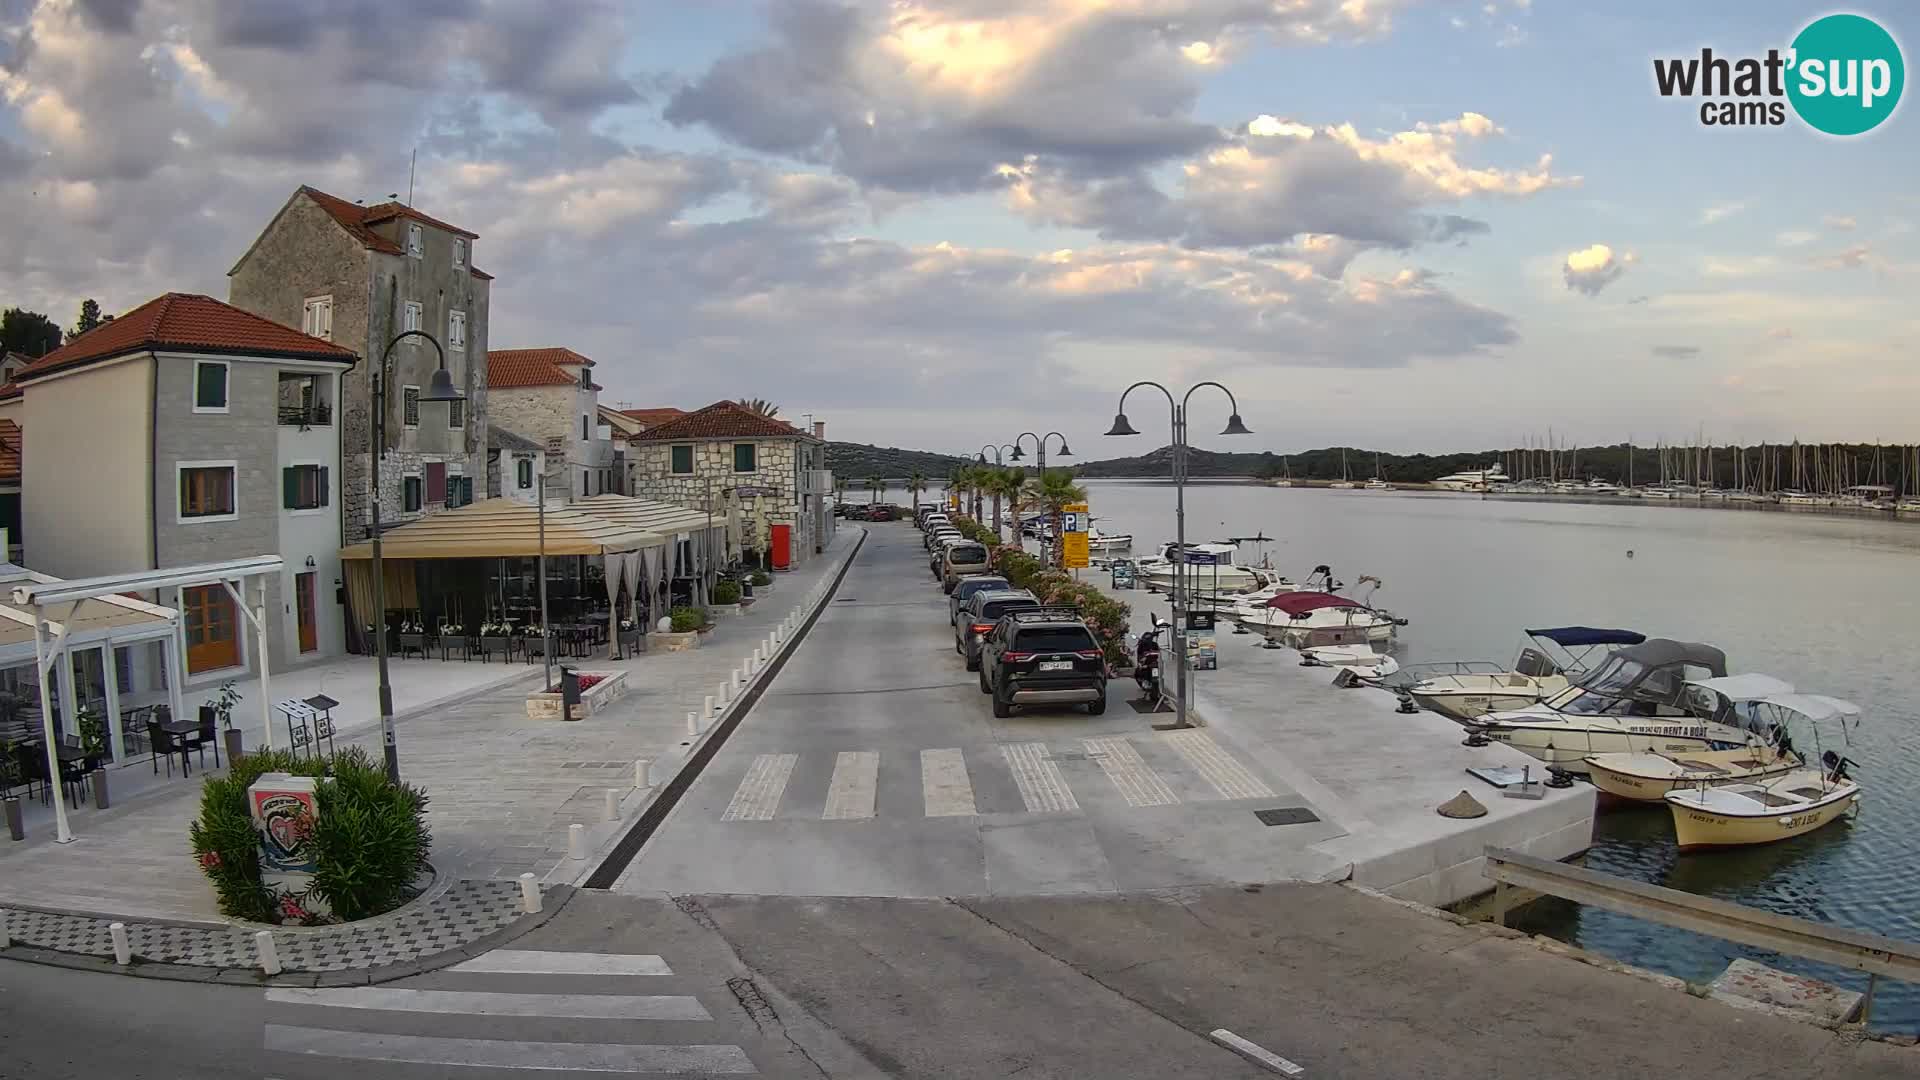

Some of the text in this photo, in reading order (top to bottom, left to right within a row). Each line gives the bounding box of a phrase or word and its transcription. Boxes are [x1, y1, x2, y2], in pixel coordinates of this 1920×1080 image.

[1065, 514, 1075, 530] P
[1663, 727, 1682, 736] RENT
[1683, 727, 1688, 736] A
[1690, 727, 1709, 737] BOAT
